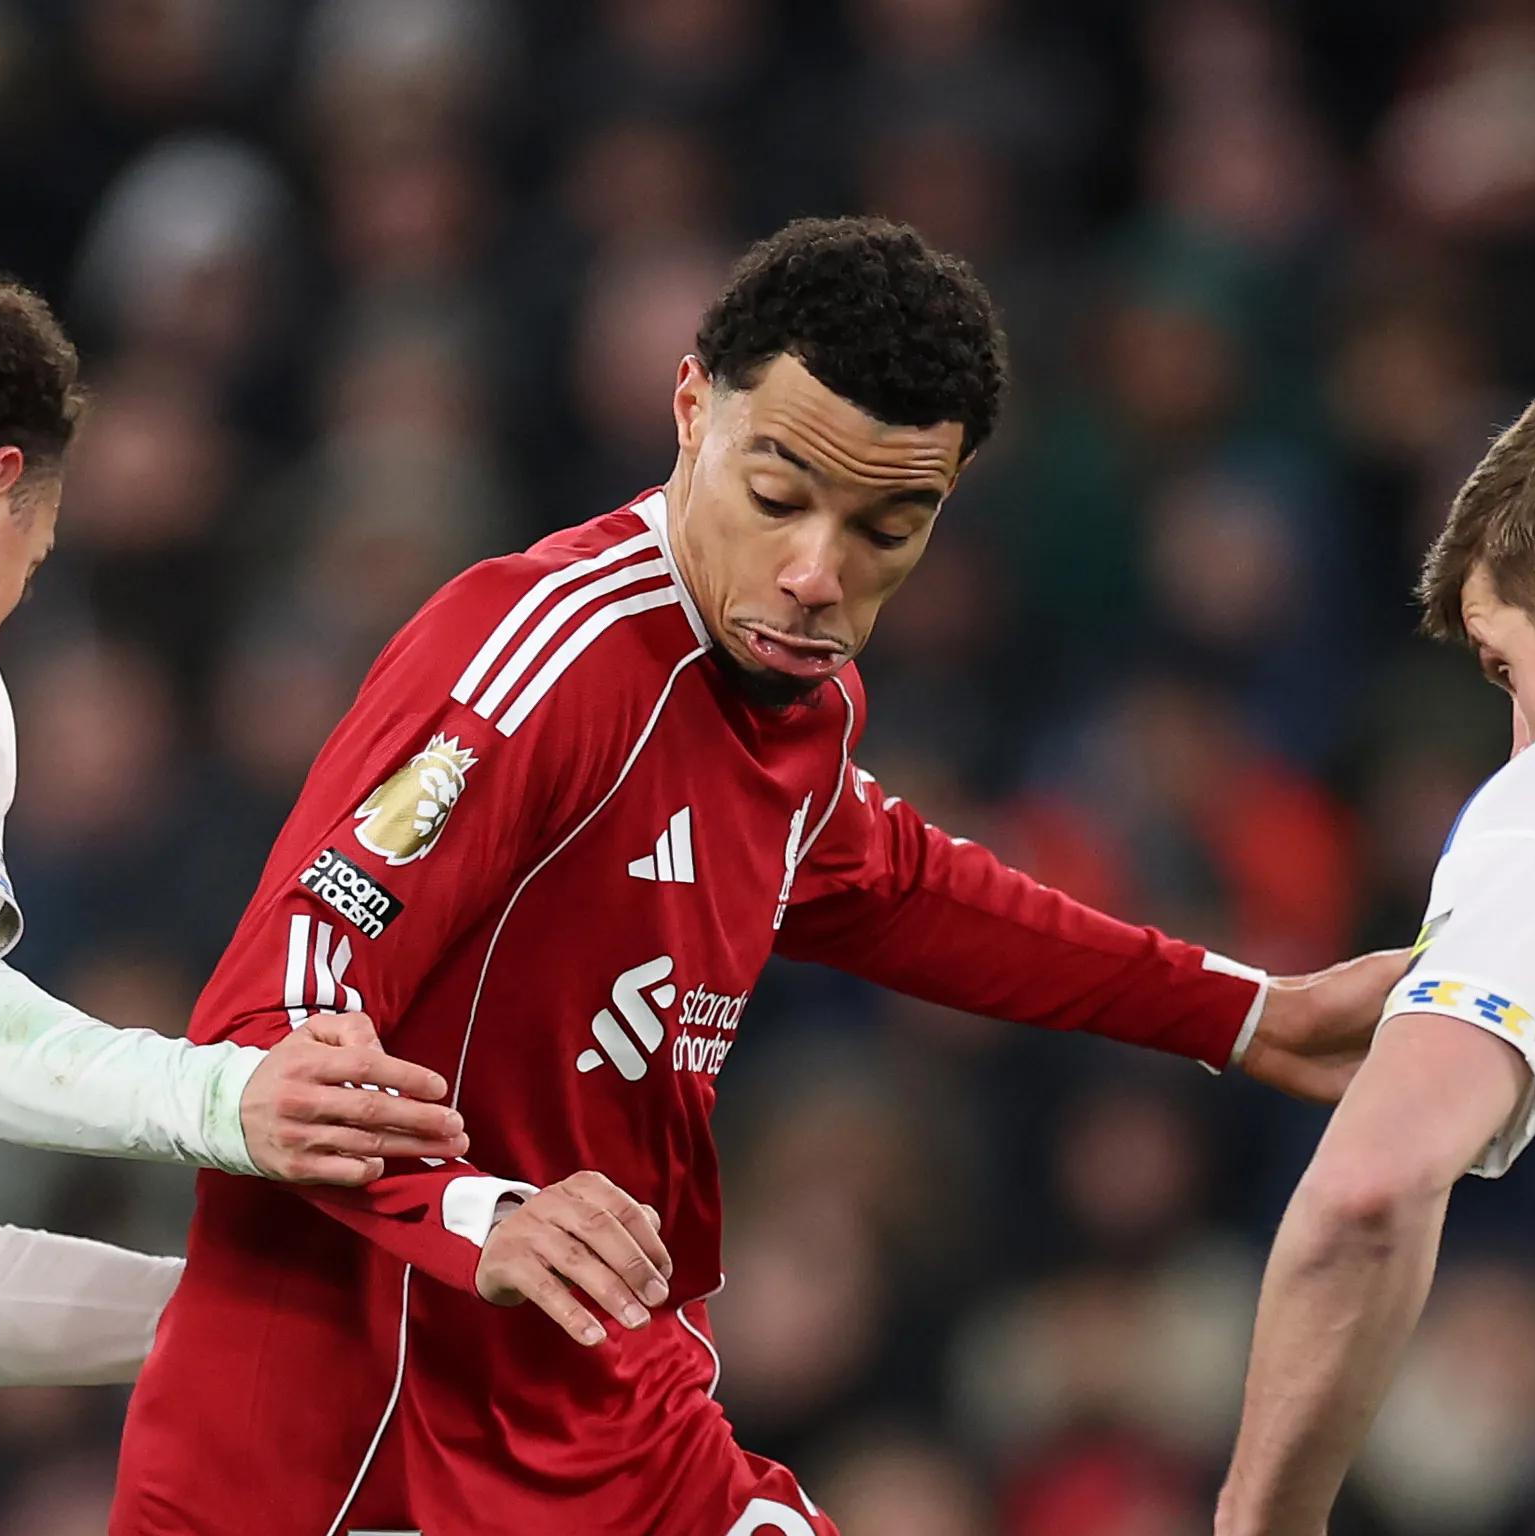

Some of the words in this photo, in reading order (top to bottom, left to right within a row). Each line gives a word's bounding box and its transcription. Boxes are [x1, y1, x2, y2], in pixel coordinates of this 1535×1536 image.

[312, 876, 384, 940] racism
[327, 859, 391, 917] room
[678, 983, 748, 1030] stand
[672, 1027, 733, 1076] charter
